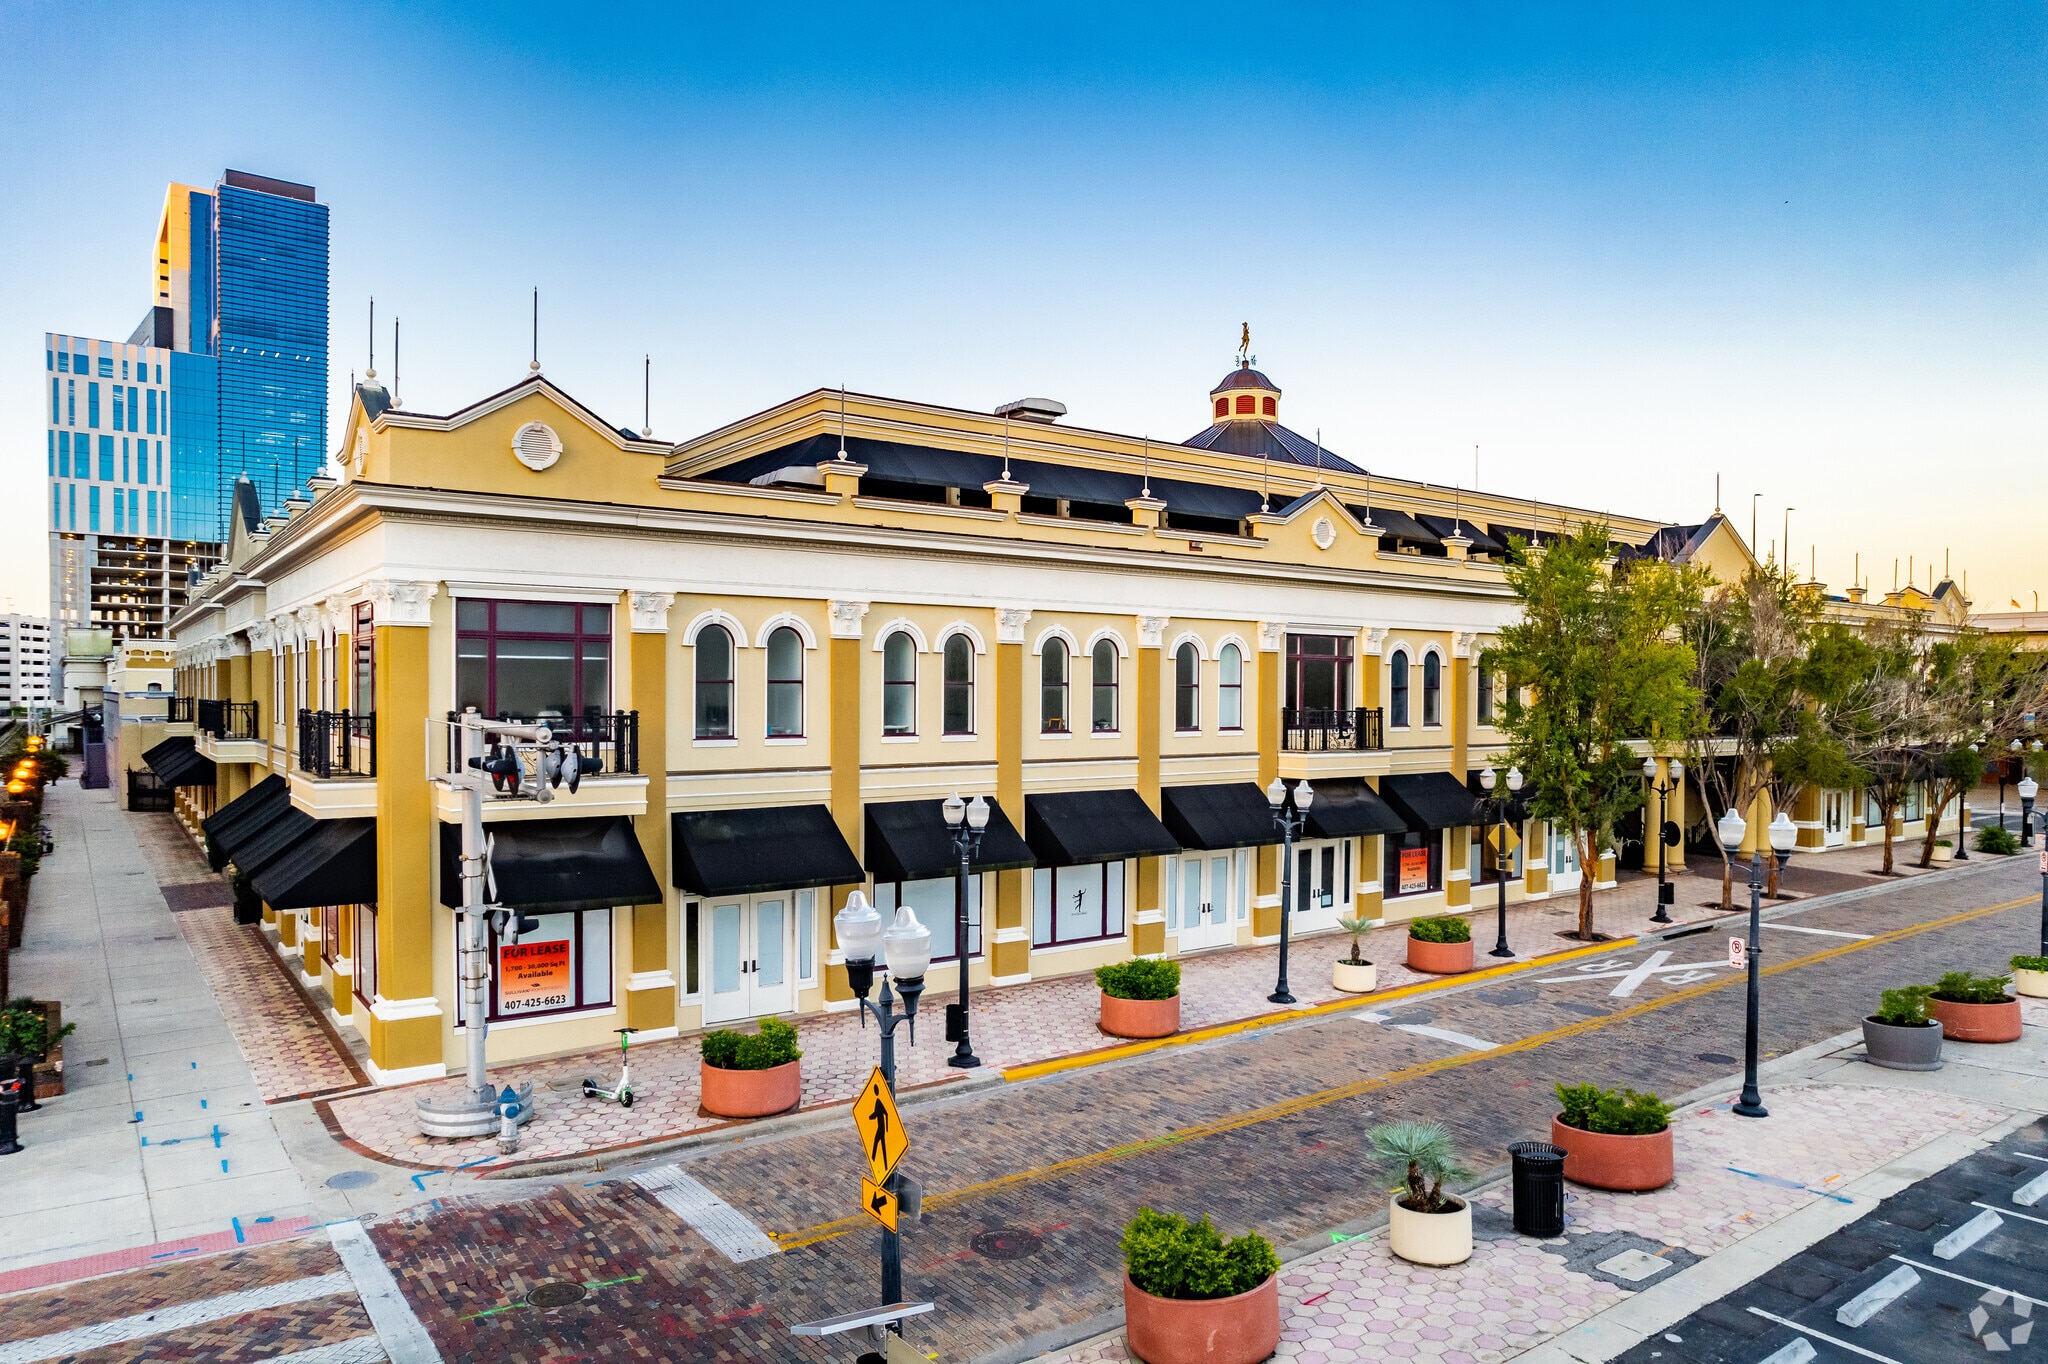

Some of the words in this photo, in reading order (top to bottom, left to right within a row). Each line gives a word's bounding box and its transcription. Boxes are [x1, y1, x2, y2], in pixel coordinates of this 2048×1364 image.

[504, 948, 528, 958] FOR
[531, 944, 566, 956] LEASE
[518, 970, 553, 979] Available
[505, 995, 566, 1010] 407-425-6623
